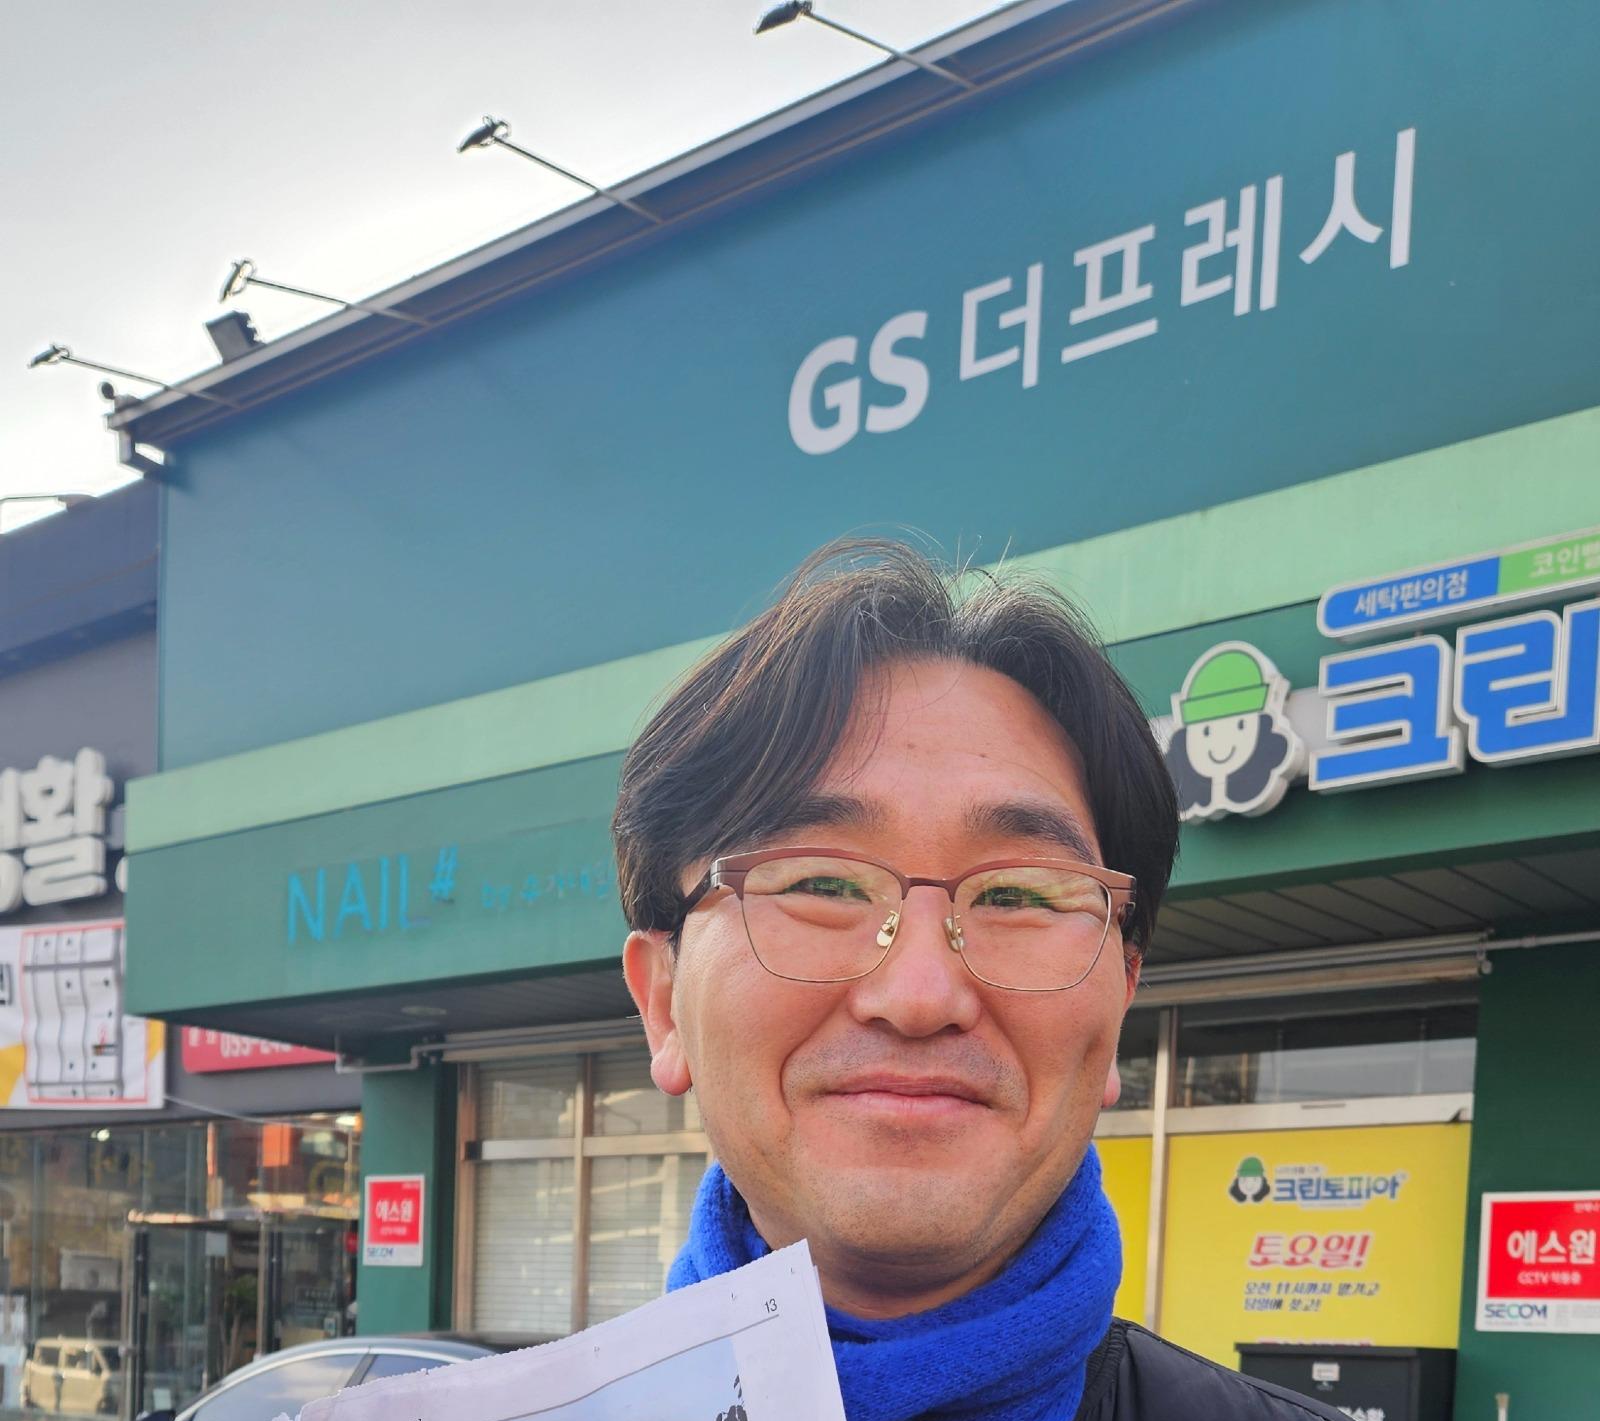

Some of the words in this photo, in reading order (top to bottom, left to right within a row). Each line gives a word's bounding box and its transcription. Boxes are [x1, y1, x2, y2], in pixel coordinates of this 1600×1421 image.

[787, 311, 931, 455] GS
[959, 127, 1417, 389] 더프레시
[1354, 570, 1468, 617] 세탁편의점
[1308, 598, 1600, 791] 크린
[1273, 1175, 1401, 1202] 크린토피아
[1249, 1234, 1371, 1269] 토요일!
[1507, 1229, 1597, 1265] 에스원
[764, 1298, 778, 1313] 13
[1484, 1304, 1548, 1320] SECOM
